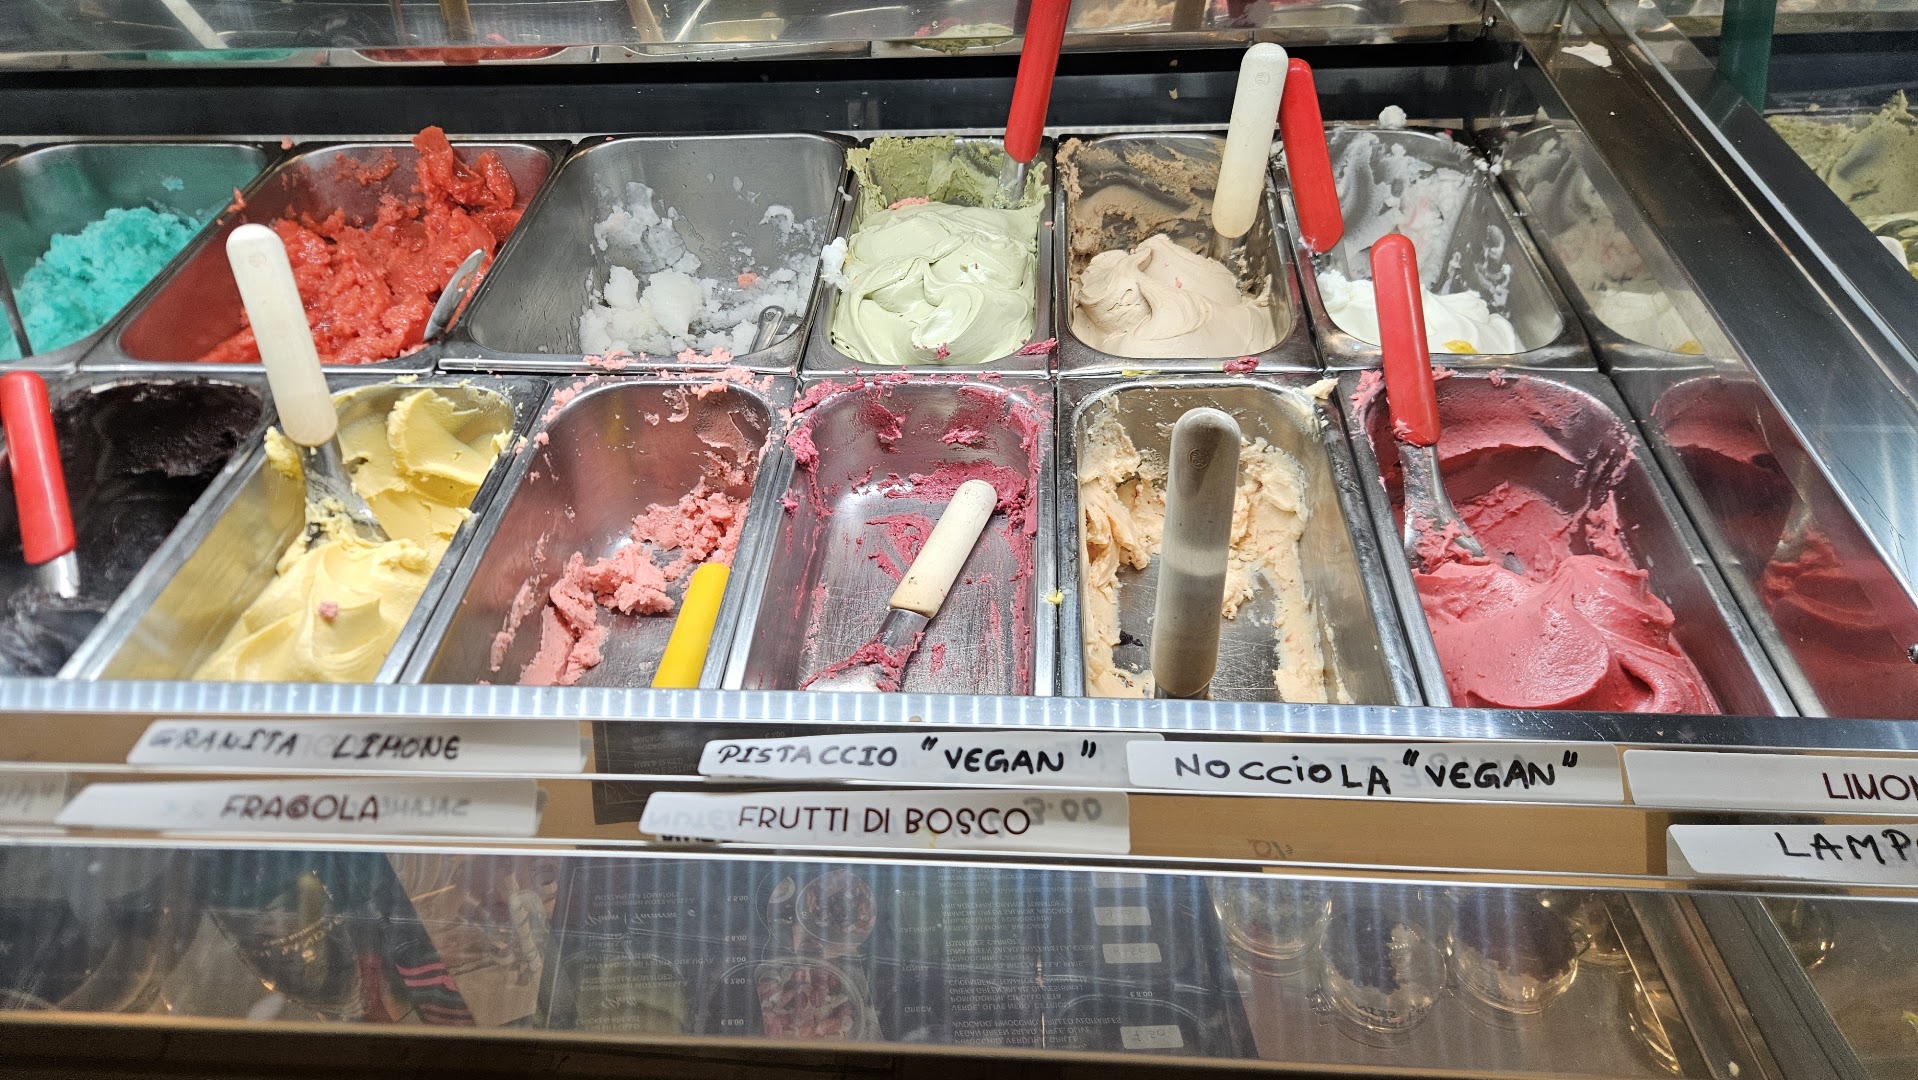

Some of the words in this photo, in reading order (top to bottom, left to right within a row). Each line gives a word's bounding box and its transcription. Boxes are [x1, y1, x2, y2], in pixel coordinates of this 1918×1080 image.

[148, 730, 298, 756] GRANITA
[332, 731, 460, 760] LIMONE
[718, 744, 897, 766] PISTACCIO
[224, 795, 379, 822] FRAGOLA
[739, 807, 849, 831] FRUTTI
[864, 808, 891, 834] DI
[905, 806, 1033, 836] BOSCO
